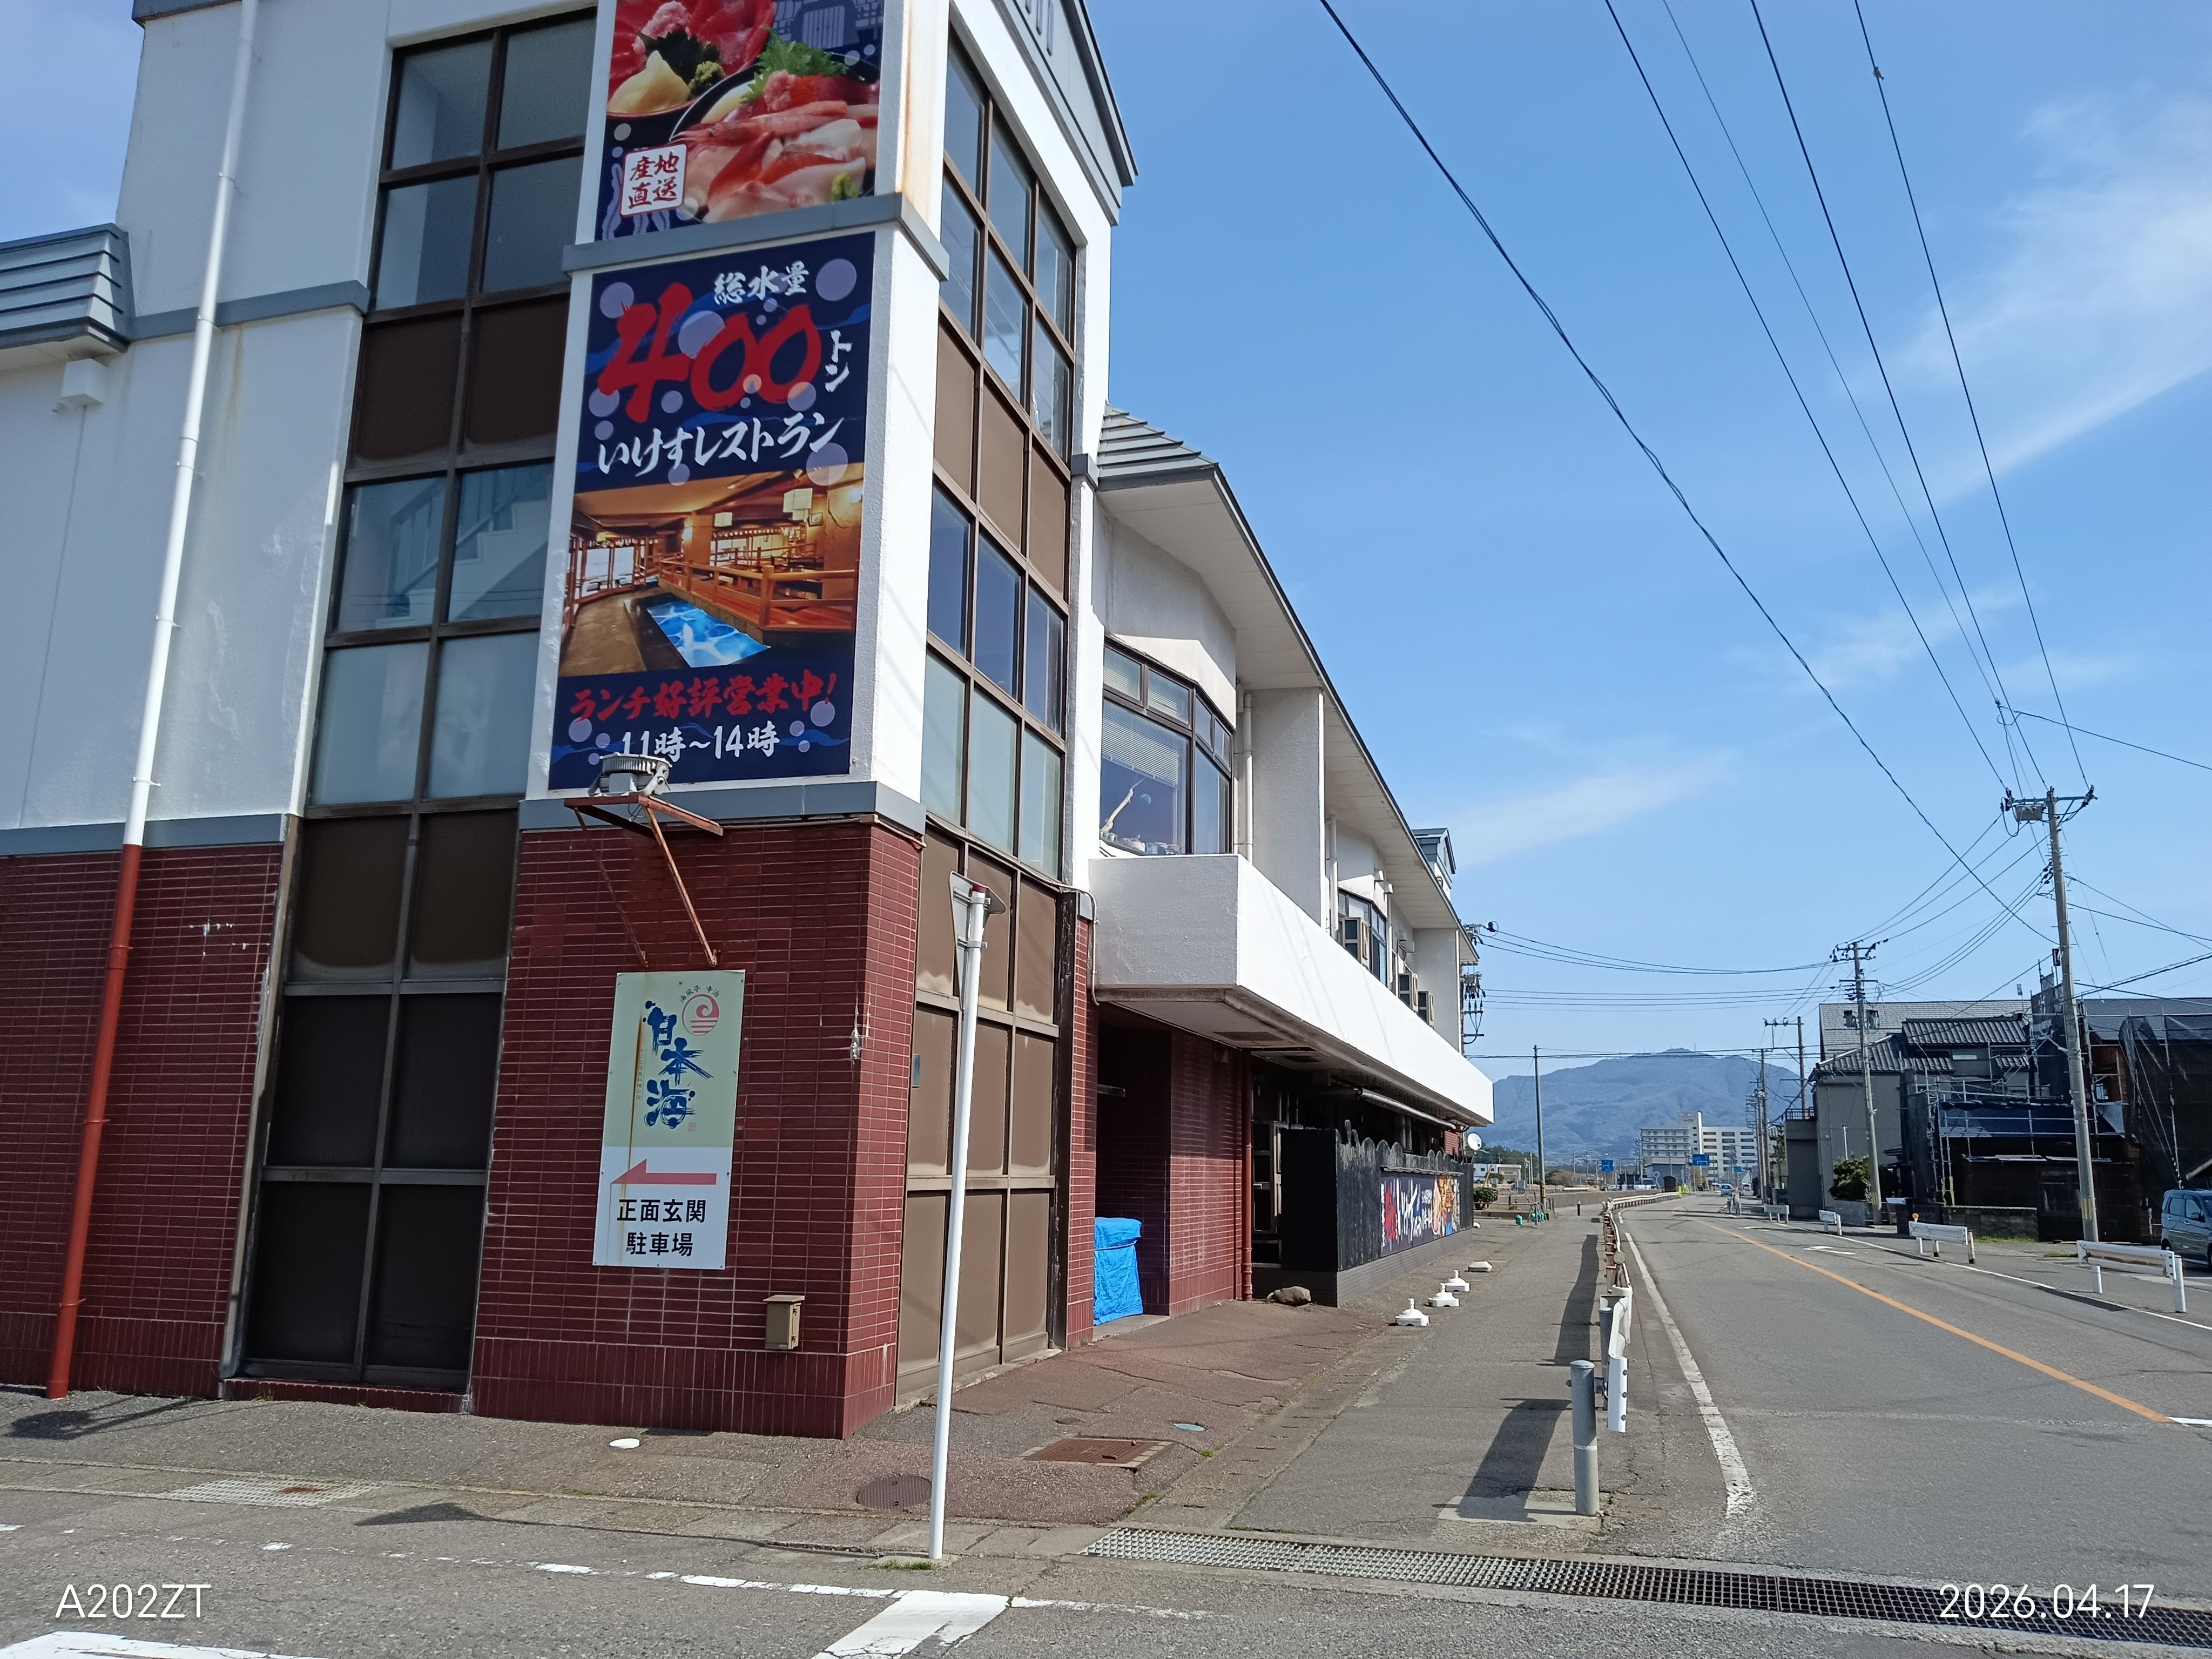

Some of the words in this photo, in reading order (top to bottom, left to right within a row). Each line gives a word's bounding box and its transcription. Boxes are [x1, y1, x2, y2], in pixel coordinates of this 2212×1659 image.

[630, 151, 679, 181] 産地
[629, 176, 677, 209] 直送
[713, 261, 809, 305] 総水量
[598, 283, 821, 423] 400
[825, 329, 852, 392] トン
[598, 412, 844, 477] いけすレストラン
[644, 1001, 714, 1129] 日本海
[617, 1199, 706, 1223] 正面玄関
[626, 1232, 693, 1257] 駐車場
